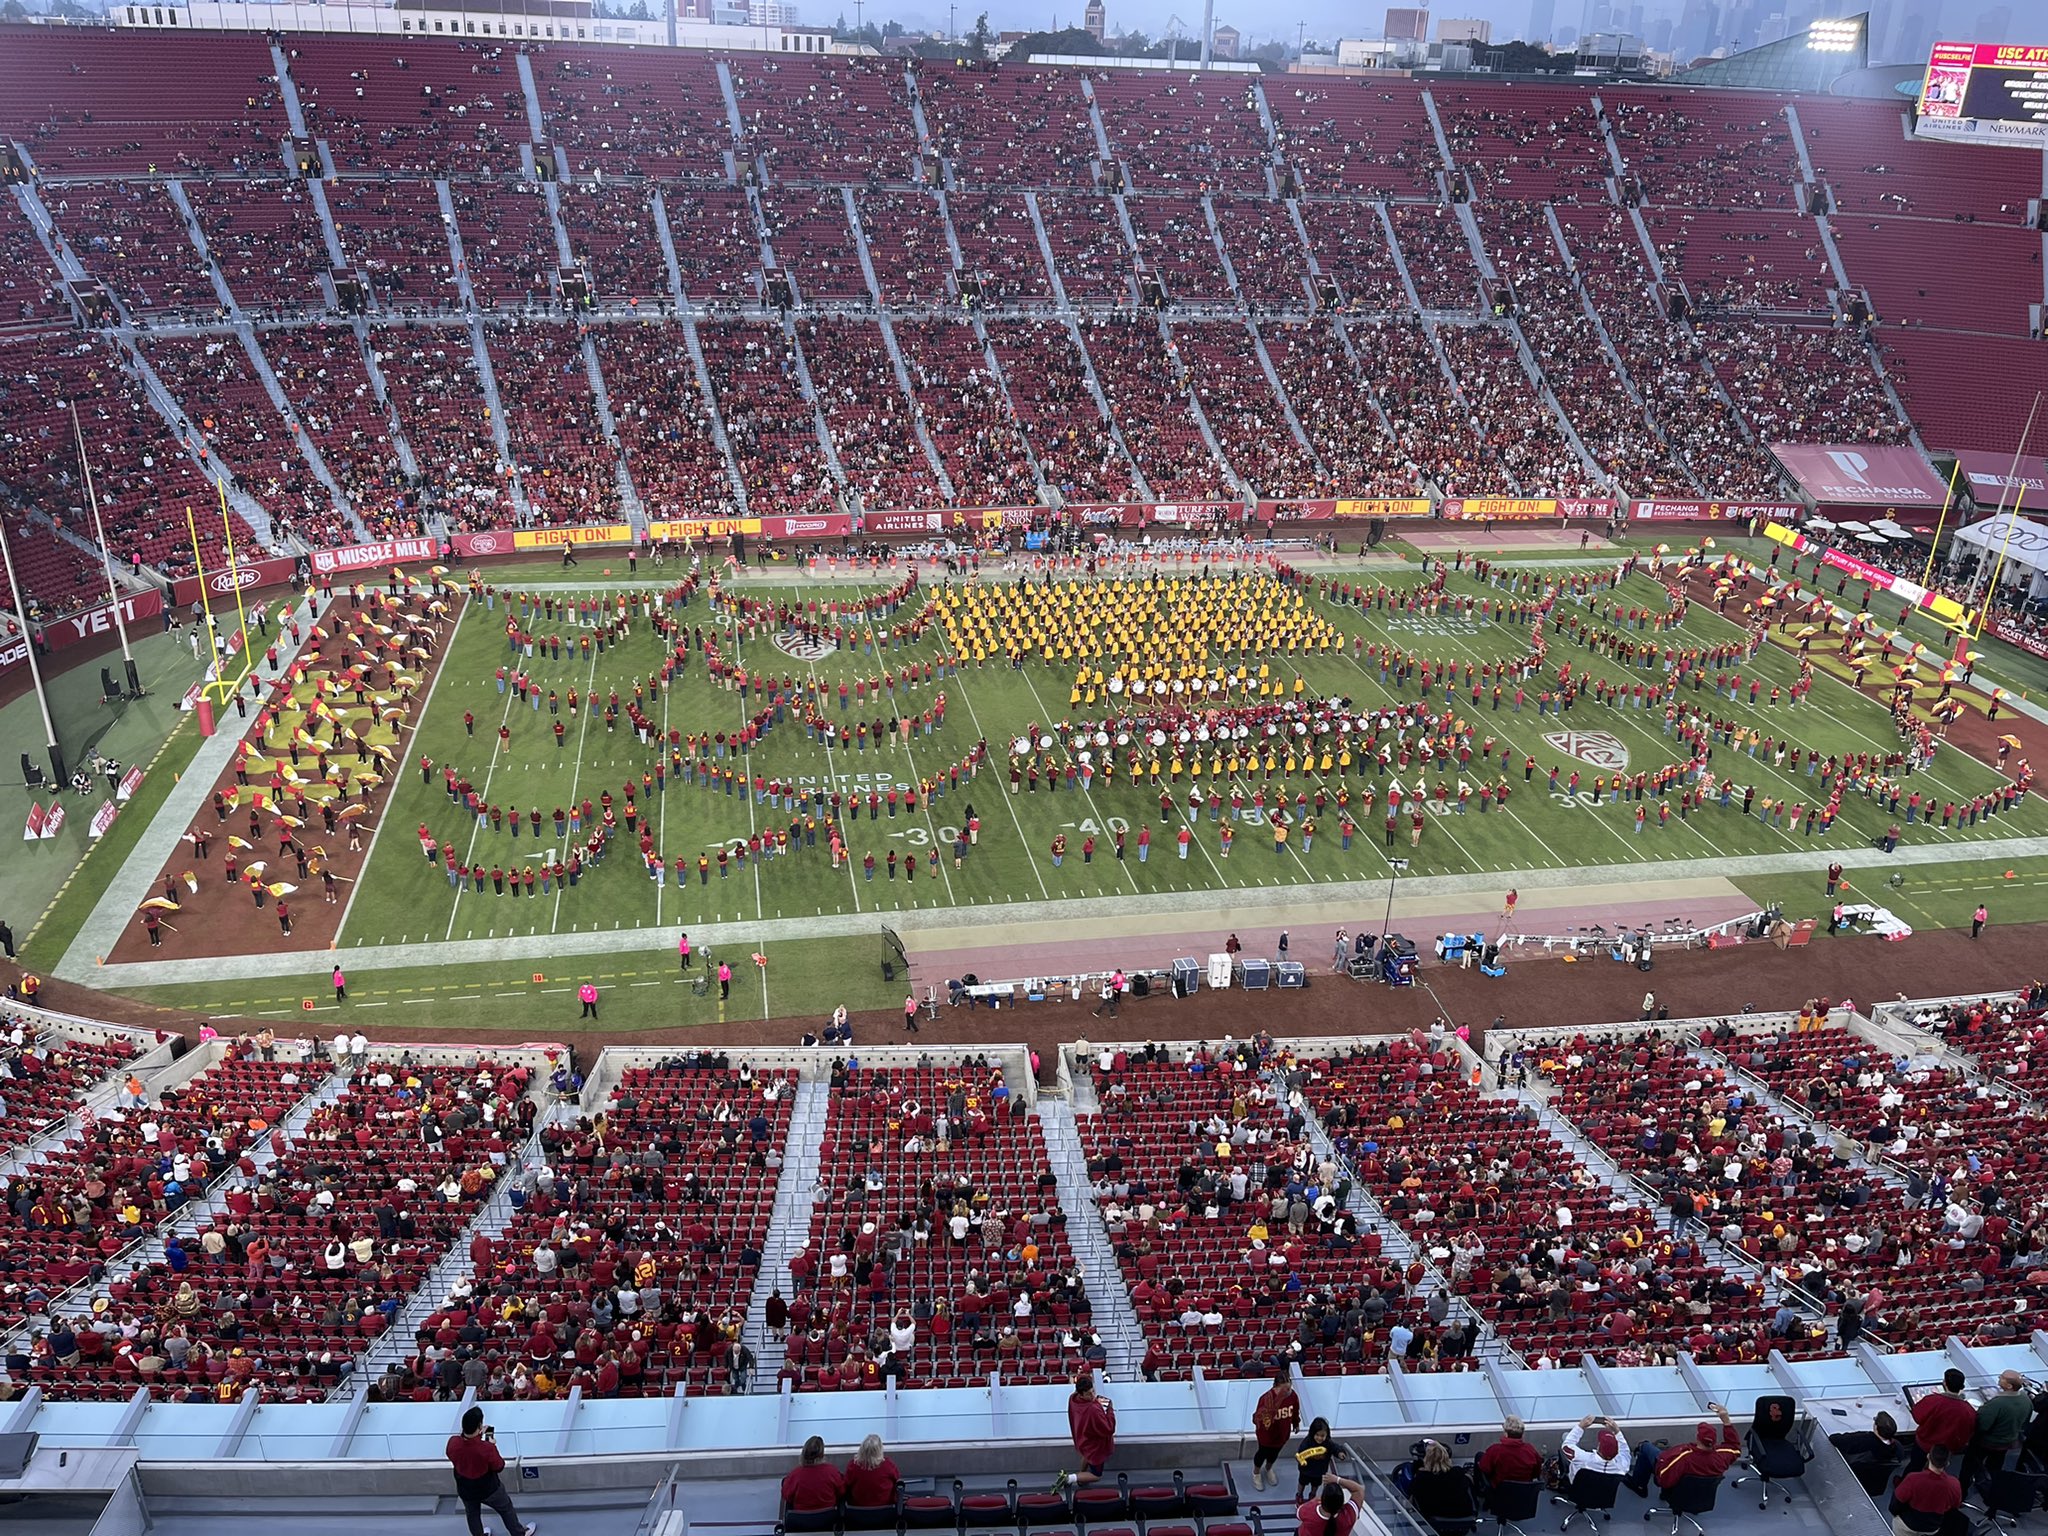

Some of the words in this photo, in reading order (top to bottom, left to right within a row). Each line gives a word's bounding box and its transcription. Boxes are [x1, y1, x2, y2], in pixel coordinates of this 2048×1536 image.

[1997, 47, 2025, 59] USC
[1923, 123, 1962, 131] AIRLINES
[1989, 124, 2047, 136] NEWMARK
[1821, 486, 1926, 495] PECHANGA
[1178, 505, 1204, 513] TURF
[1352, 501, 1390, 512] FIGHT
[1392, 501, 1414, 511] ON!
[1479, 500, 1516, 512] FIGHT
[1519, 500, 1540, 511] ON!
[1002, 509, 1034, 518] CREDIT
[1774, 507, 1797, 518] MILK
[875, 522, 924, 530] AIRLINES
[1002, 517, 1032, 525] UNION
[670, 522, 712, 536] FIGHT
[717, 520, 742, 532] ON!
[535, 529, 581, 545] FIGHT
[585, 528, 612, 541] ON!
[338, 543, 393, 566] MUSCLE
[393, 542, 431, 558] MILK
[1873, 572, 1893, 585] GROUP
[71, 600, 135, 638] YETI
[1996, 624, 2023, 641] ROCKET
[776, 772, 893, 786] UNITED
[762, 782, 911, 798] ARLINES
[1550, 790, 1605, 808] 30
[1241, 807, 1294, 827] 50
[1078, 816, 1130, 836] 40
[906, 825, 961, 846] 30
[534, 974, 542, 982] 10
[304, 1001, 312, 1010] G
[1663, 1240, 1670, 1255] 9
[1755, 1289, 1763, 1297] 7
[643, 1324, 654, 1337] 15
[674, 1346, 681, 1356] 2
[868, 1363, 875, 1374] 9
[220, 1384, 231, 1398] 10
